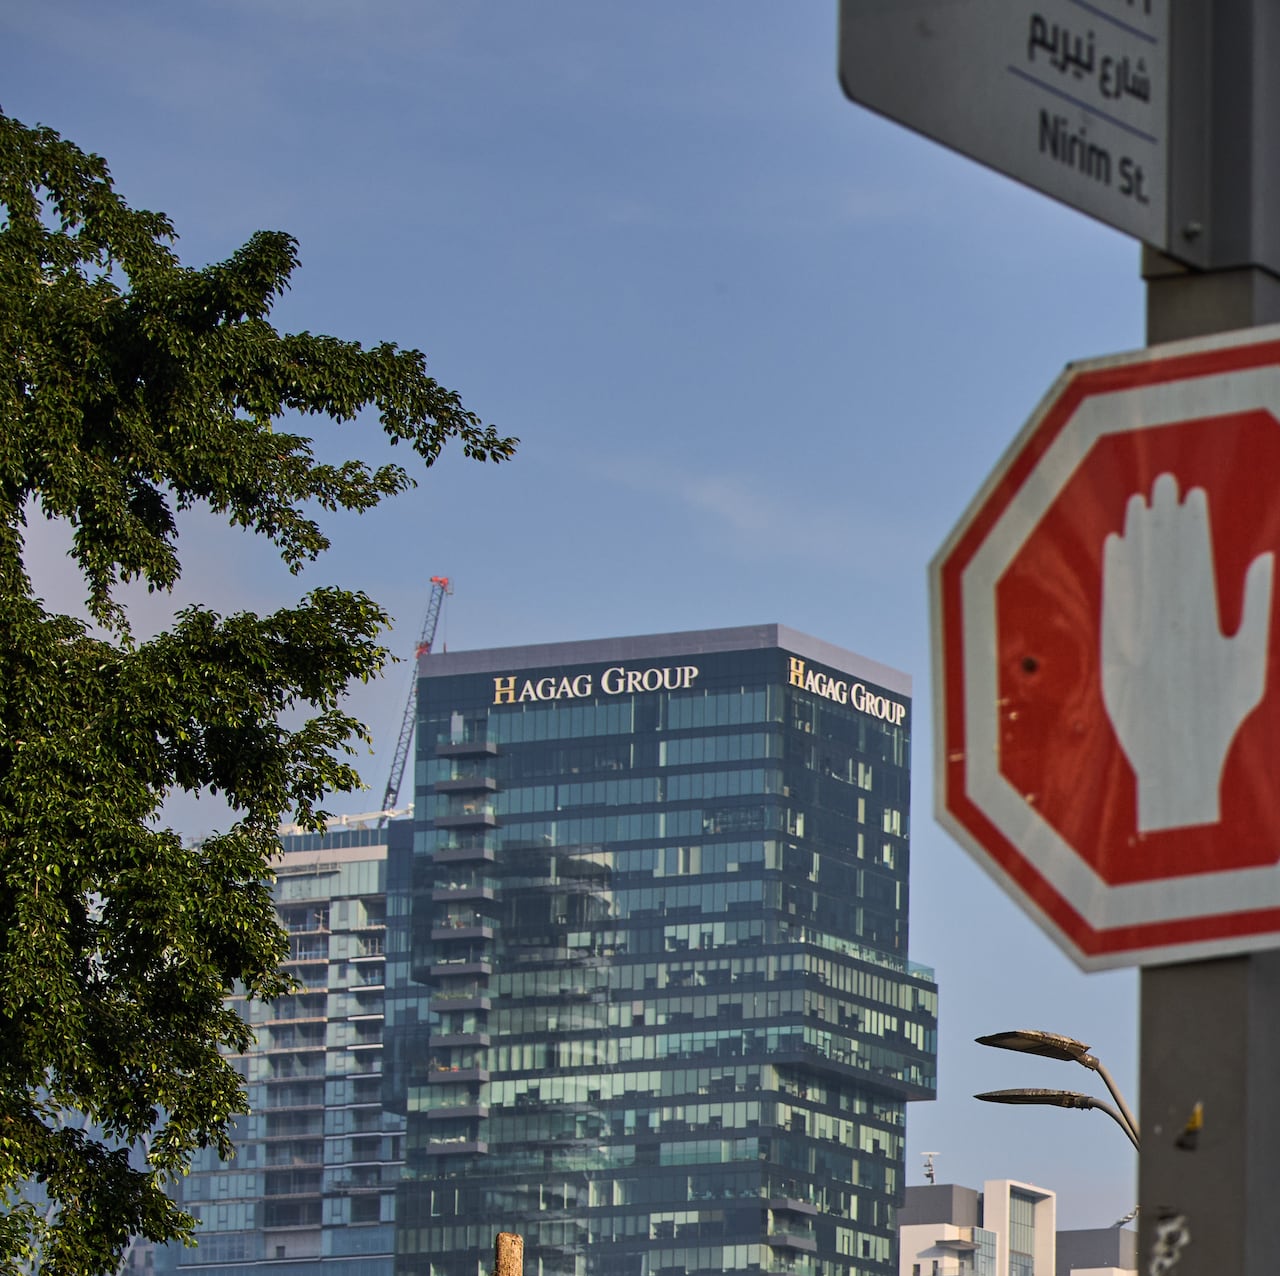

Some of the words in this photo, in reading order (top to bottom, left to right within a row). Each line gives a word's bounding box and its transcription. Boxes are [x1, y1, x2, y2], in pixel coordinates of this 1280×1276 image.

[1028, 12, 1095, 79] نيريم
[1099, 55, 1150, 104] شارع
[1039, 108, 1112, 187] Nirim
[1119, 156, 1149, 206] St.
[492, 673, 592, 705] HAGAG
[601, 665, 699, 695] GROUP
[787, 656, 847, 705] HAGAG
[850, 684, 906, 726] GROUP
